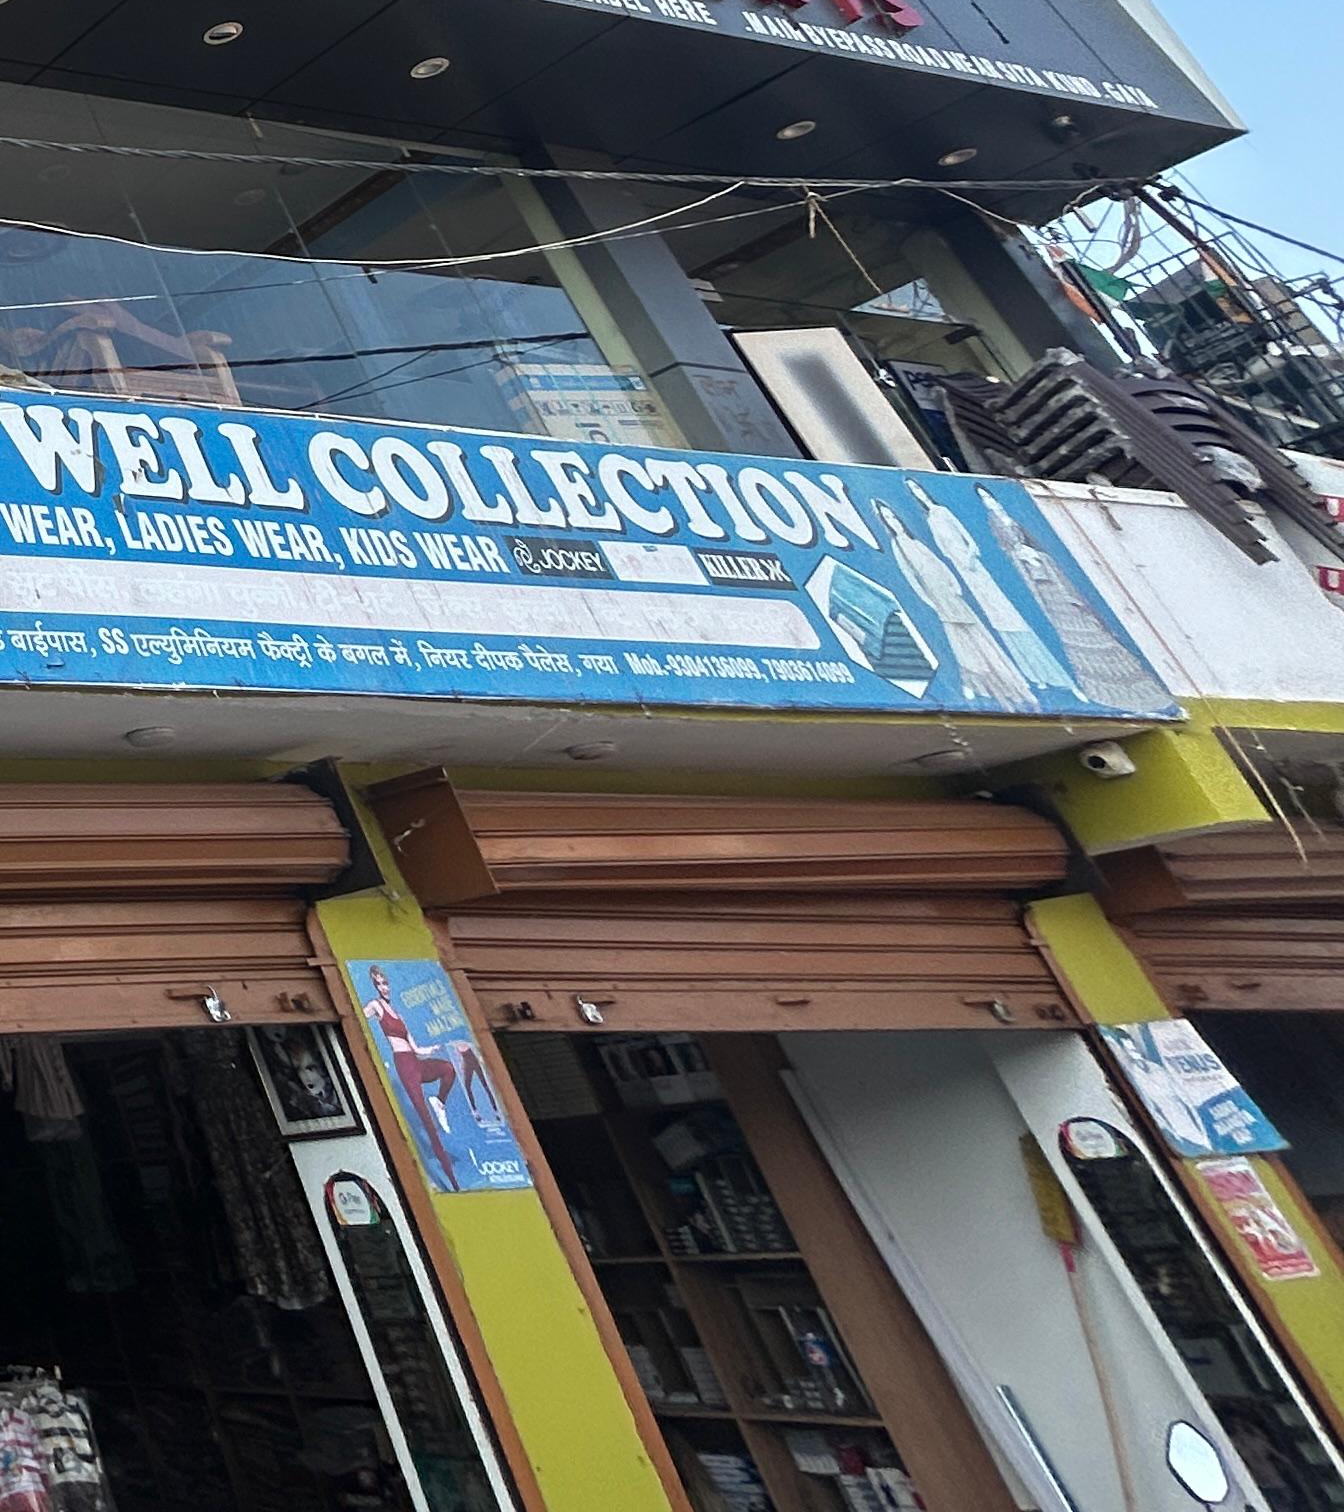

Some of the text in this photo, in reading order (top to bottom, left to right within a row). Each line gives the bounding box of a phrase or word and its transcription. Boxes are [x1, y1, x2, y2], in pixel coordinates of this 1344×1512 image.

[800, 24, 897, 61] BYEPASS
[887, 39, 952, 71] ROAD
[949, 50, 1004, 80] NEAR
[997, 61, 1046, 88] SITA
[307, 423, 884, 552] COLLECTION
[115, 509, 235, 557] LADIES
[232, 518, 346, 570] WEAR,
[339, 527, 418, 569] KIDS
[413, 532, 512, 574] WEAR
[539, 548, 606, 573] JOCKEY
[698, 553, 771, 581] KILLER
[11, 621, 97, 658] बाईपास,
[98, 627, 130, 655] SS
[131, 627, 257, 664] एल्युमिनियम
[313, 635, 337, 663] के
[338, 643, 390, 666] बगल
[389, 638, 422, 672] में,
[422, 640, 472, 669] नियर
[472, 642, 522, 672] दीपक
[522, 644, 583, 678] पैलेस,
[578, 653, 620, 675] गया
